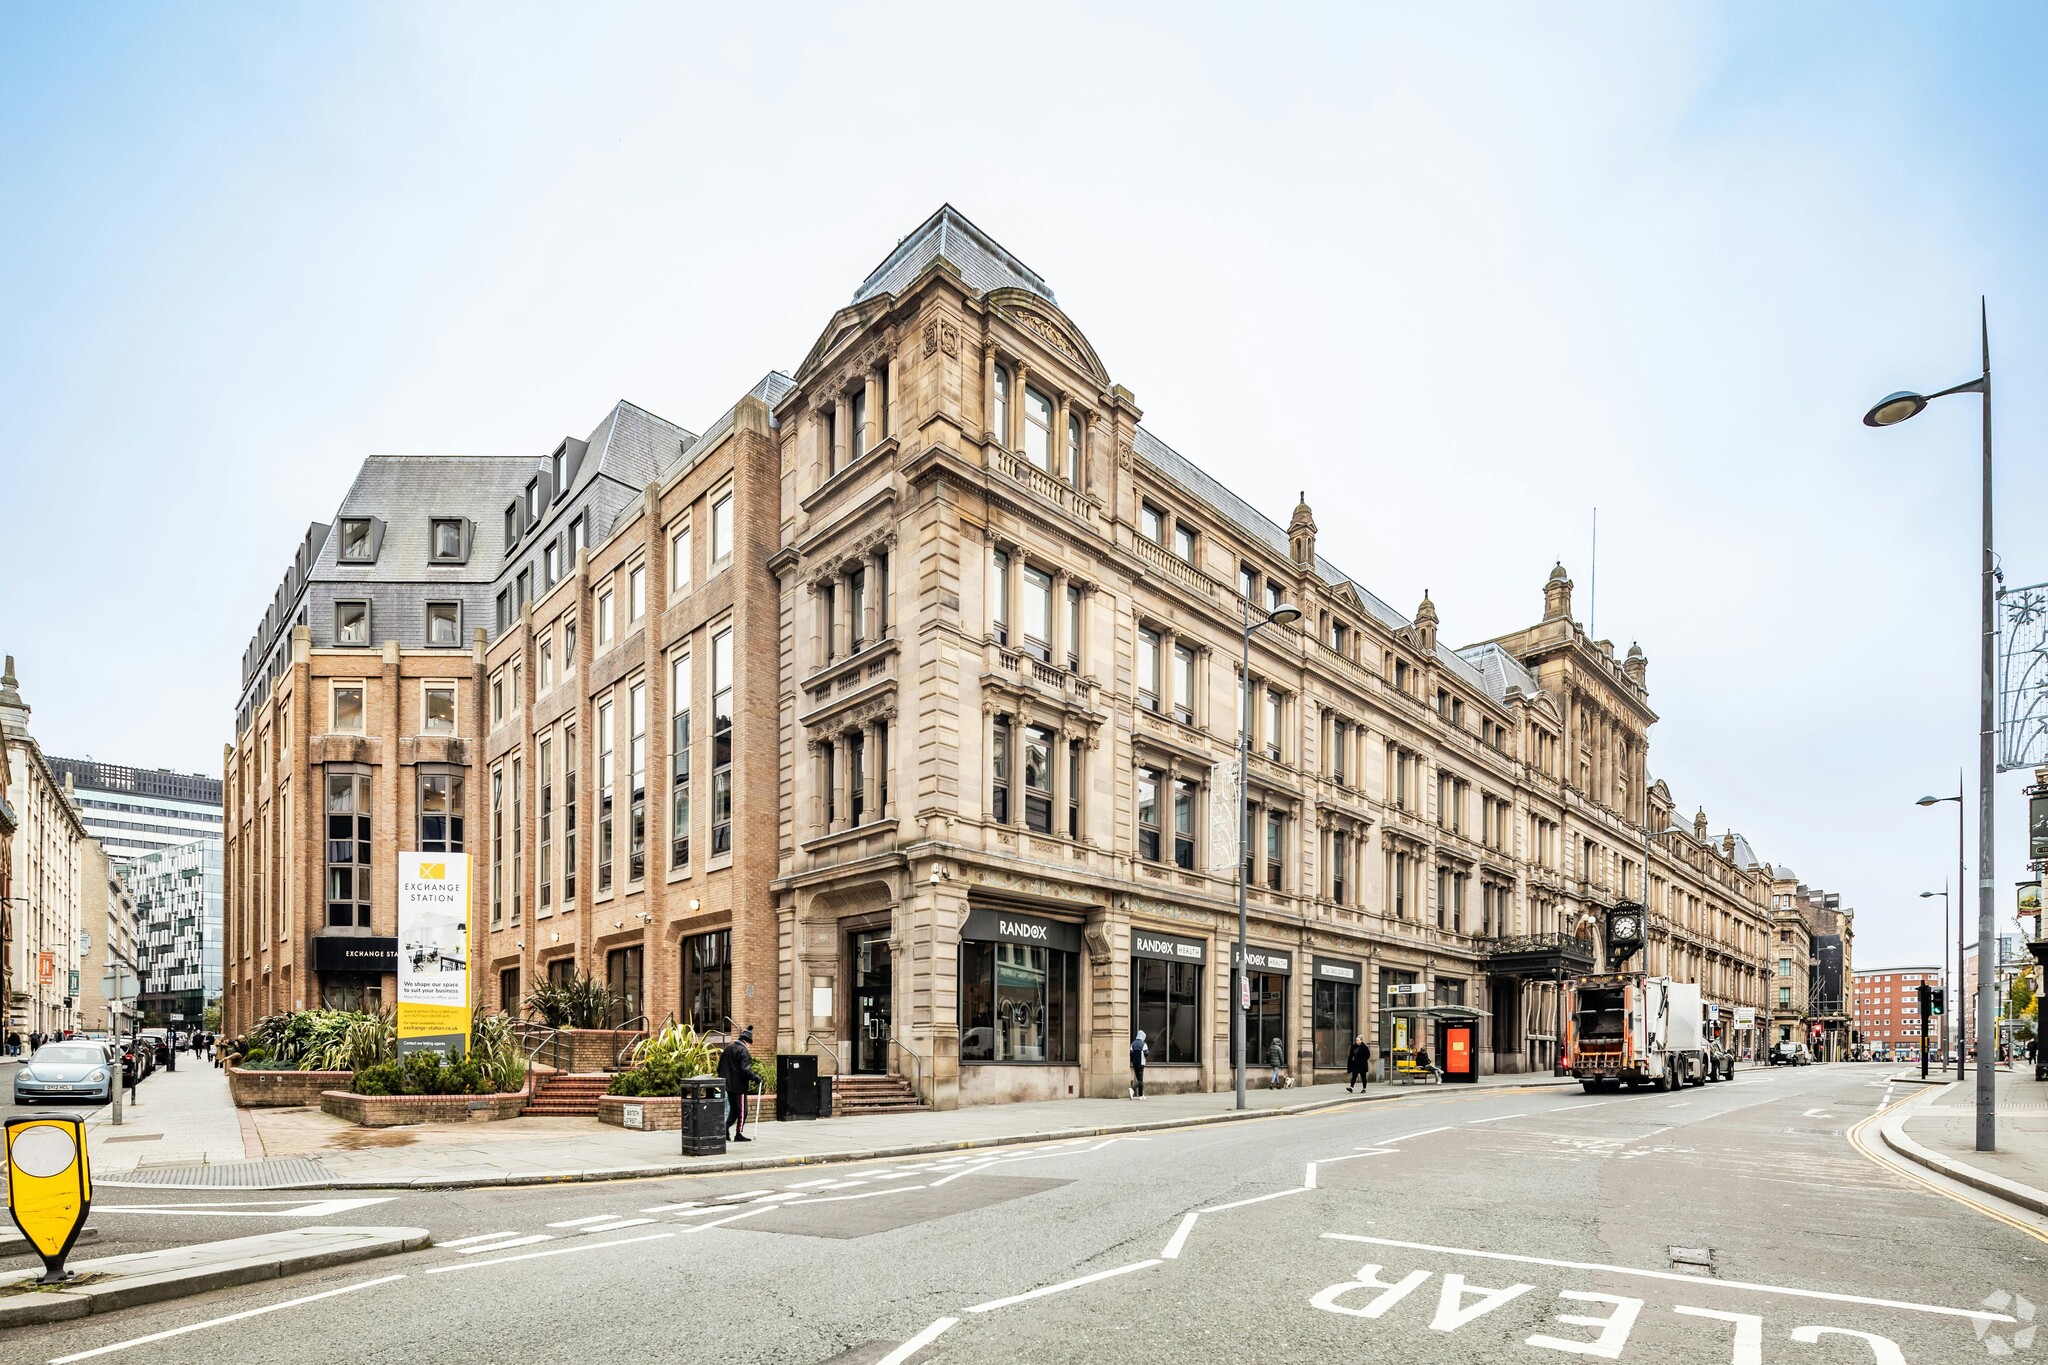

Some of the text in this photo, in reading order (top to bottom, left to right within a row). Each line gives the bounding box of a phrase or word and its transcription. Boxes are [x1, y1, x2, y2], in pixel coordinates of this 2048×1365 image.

[404, 882, 460, 892] EXCHANGE
[410, 893, 454, 902] STATION
[1000, 920, 1047, 940] RANDOX
[1137, 938, 1200, 956] RANDOX HEALTH
